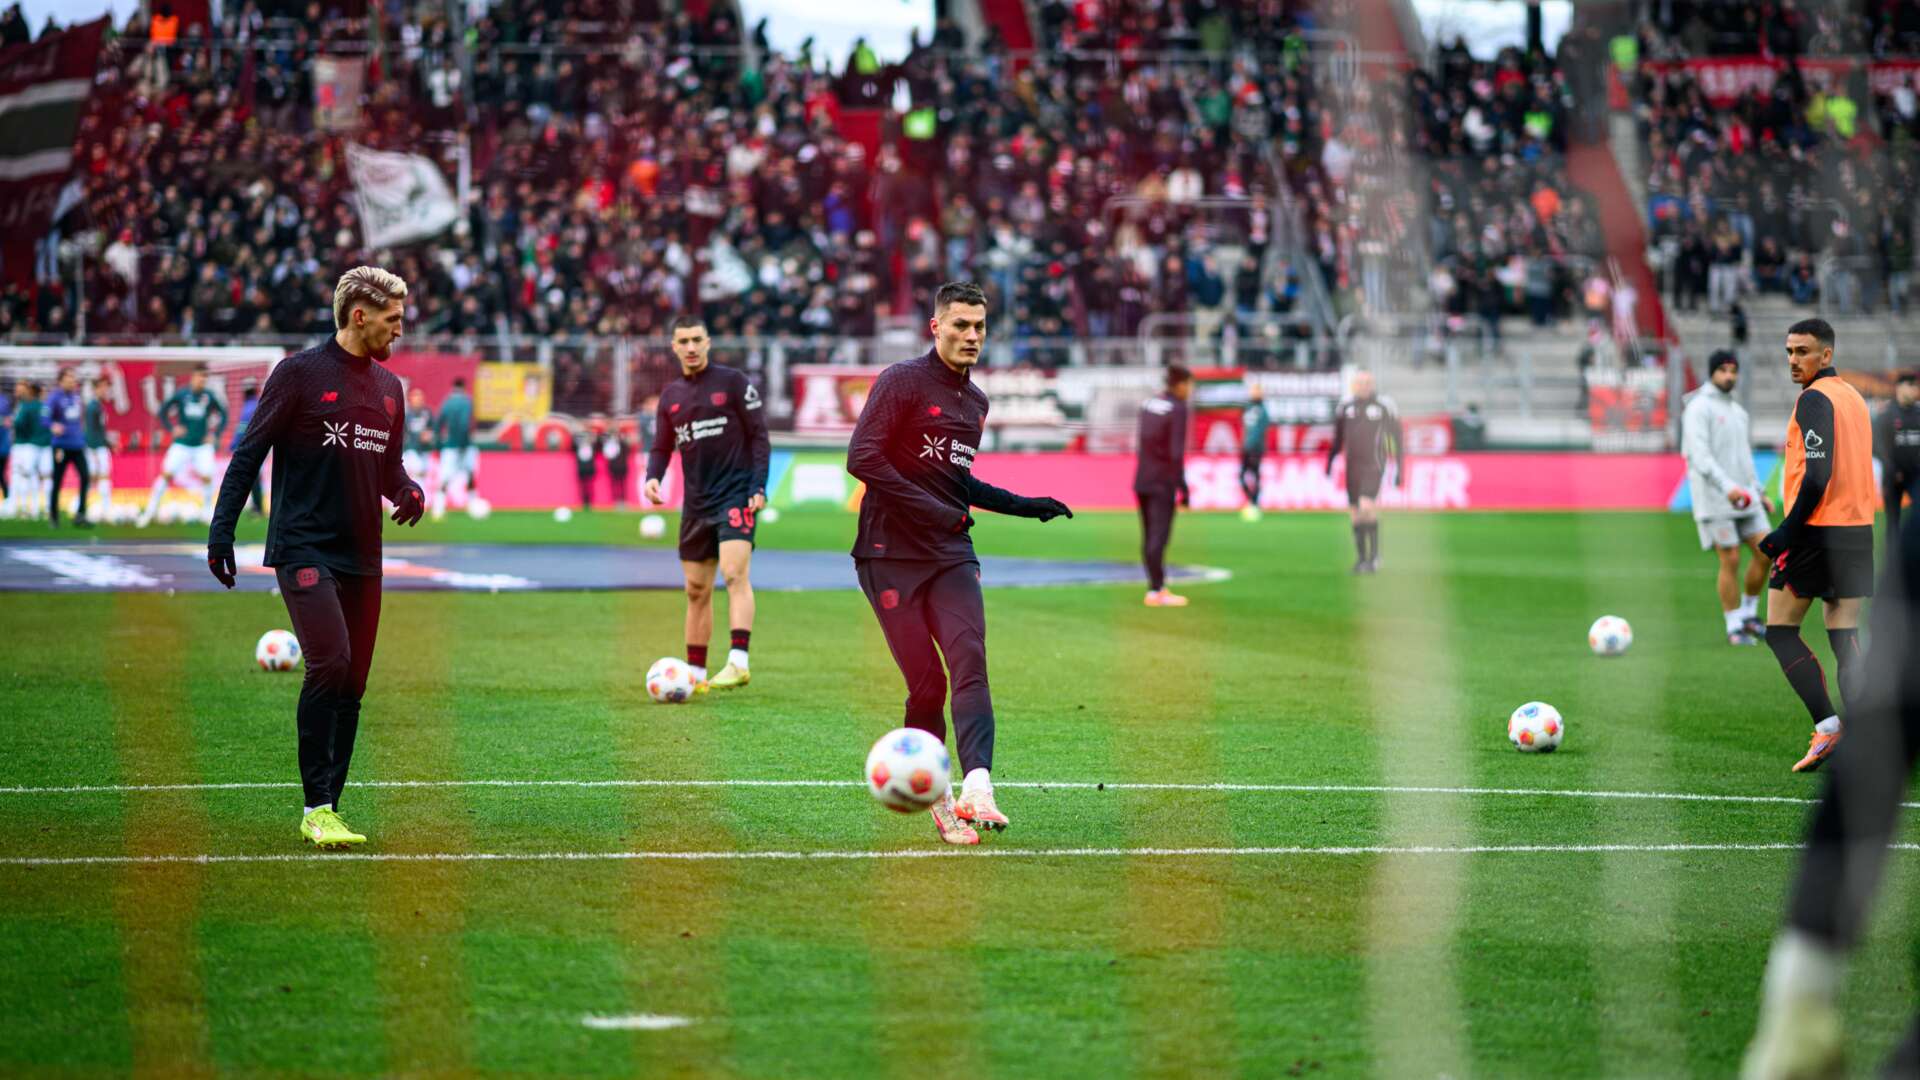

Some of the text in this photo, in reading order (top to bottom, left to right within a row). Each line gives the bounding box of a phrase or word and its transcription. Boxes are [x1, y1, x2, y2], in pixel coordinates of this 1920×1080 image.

[354, 424, 390, 440] Barmeni
[354, 438, 387, 453] Gothaer
[952, 440, 976, 455] Barme
[950, 453, 972, 467] Gotha
[1806, 451, 1826, 459] EDAX
[727, 506, 755, 528] 30
